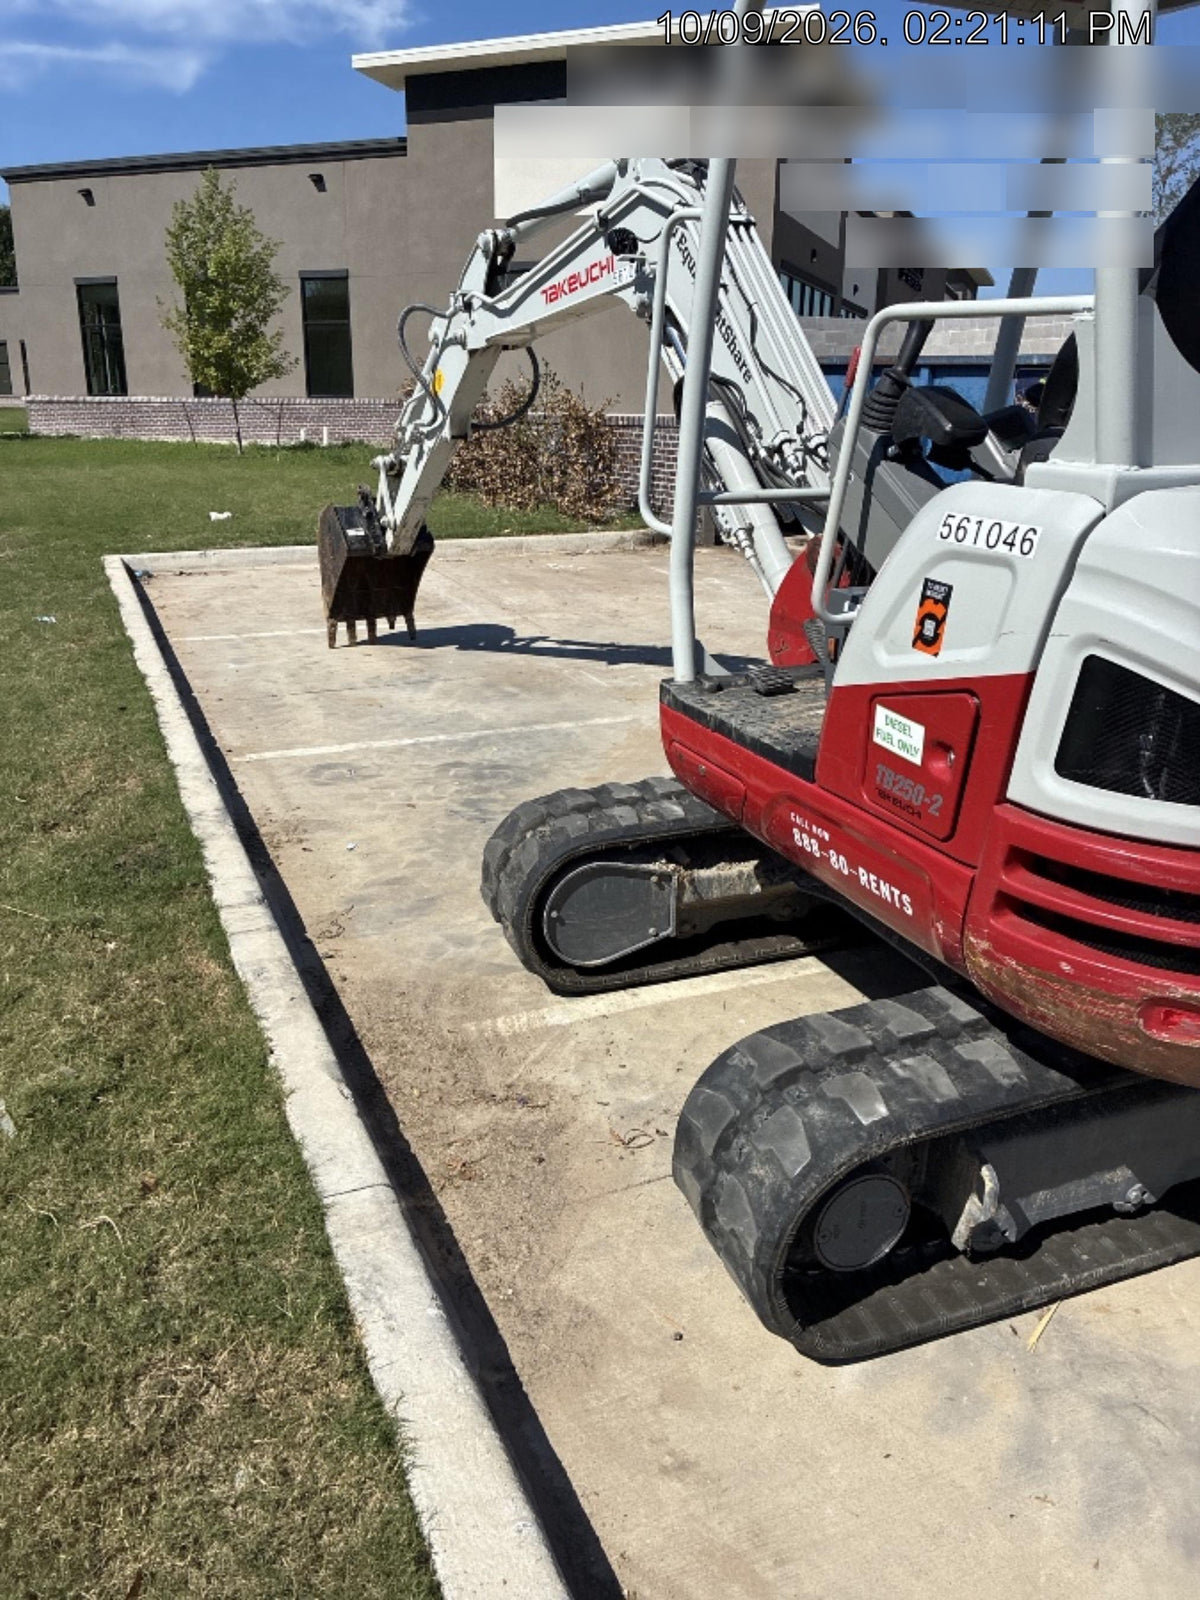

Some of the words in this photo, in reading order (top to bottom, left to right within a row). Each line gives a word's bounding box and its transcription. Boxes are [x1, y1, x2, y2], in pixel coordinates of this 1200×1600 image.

[677, 232, 752, 384] EqutShare
[940, 514, 1037, 555] 561046
[876, 727, 895, 747] FUEL
[897, 739, 920, 757] ONLY
[885, 714, 912, 738] DIESEL
[876, 764, 943, 816] TB250-2
[790, 811, 809, 831] CALL
[811, 824, 830, 842] NOW
[792, 828, 913, 916] 888-80-RENTS
